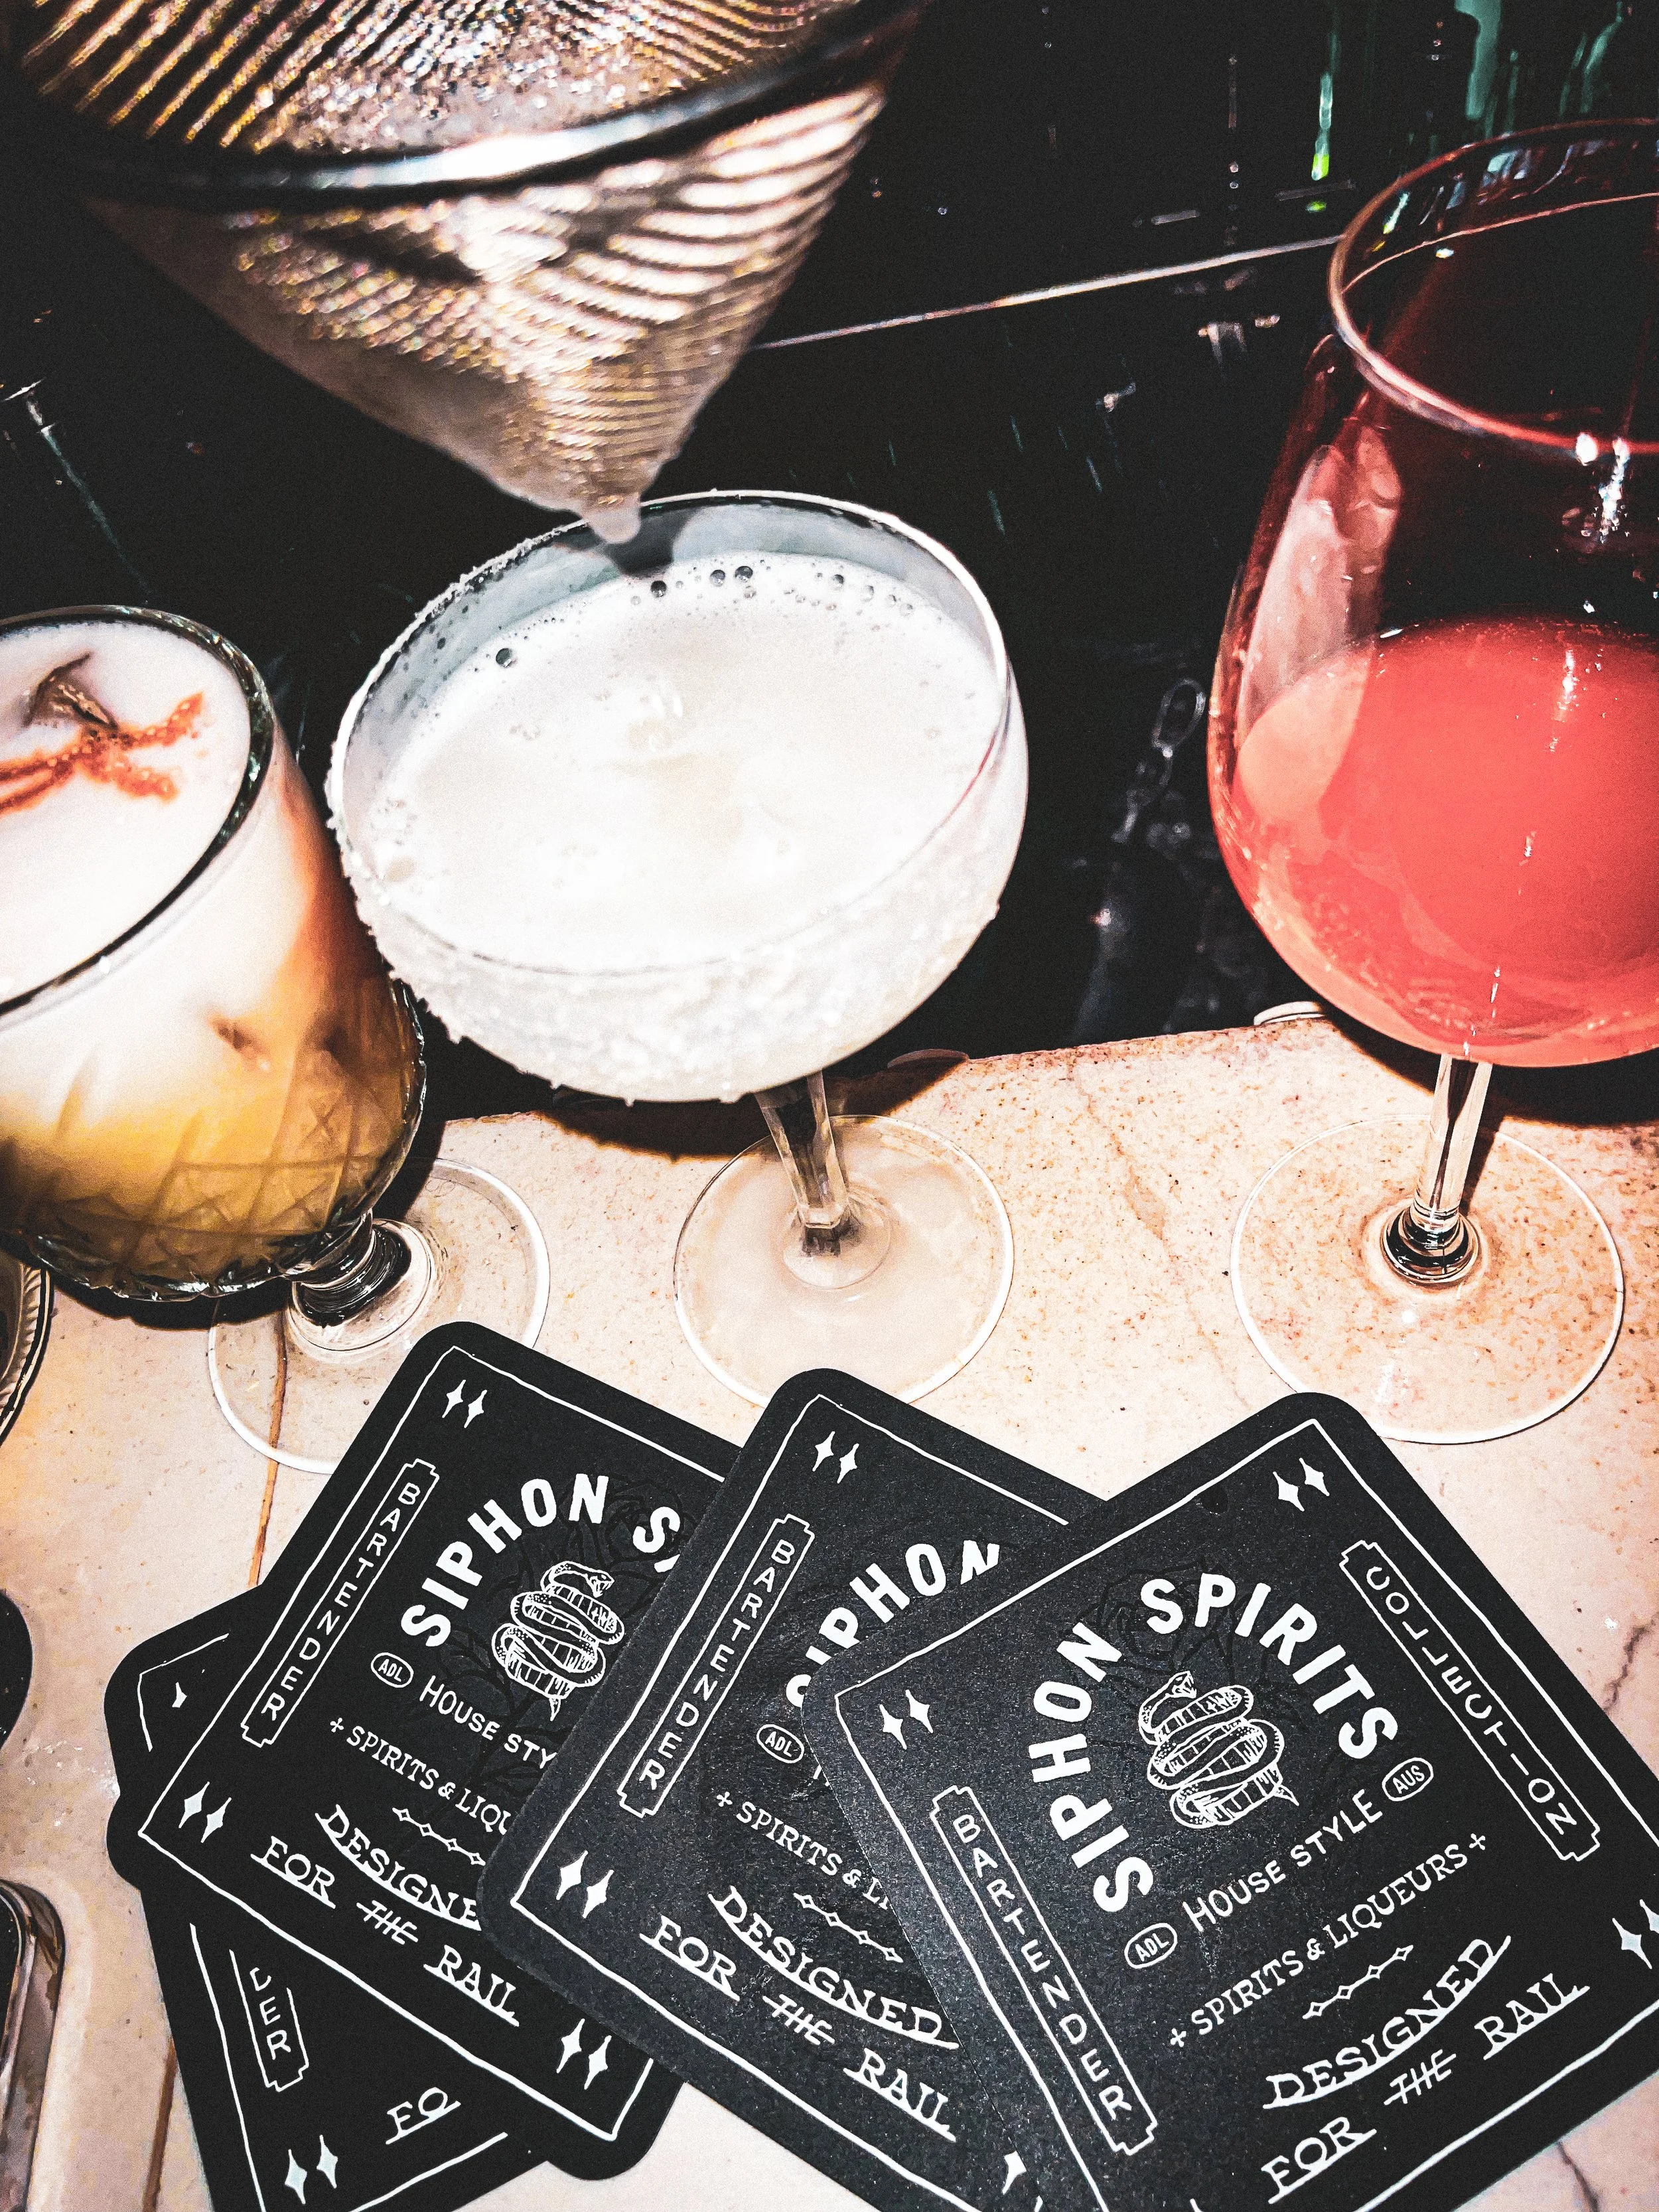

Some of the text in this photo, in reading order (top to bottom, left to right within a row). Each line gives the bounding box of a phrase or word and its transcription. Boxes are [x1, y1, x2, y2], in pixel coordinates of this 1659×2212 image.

[261, 1483, 420, 1720] BARTENDER
[401, 1474, 609, 1646] SIPHON
[378, 1659, 402, 1681] ADL
[420, 1676, 500, 1740] HOUSE
[639, 1540, 794, 1790] BARTENDER
[765, 1732, 791, 1757] ADL
[1029, 1573, 1398, 1912] SIPHON SPIRITS
[1367, 1567, 1577, 1834] COLLECTION
[347, 1726, 439, 1789] SPIRITS
[439, 1783, 455, 1799] &
[737, 1802, 861, 1887] SPIRITS &
[1394, 1766, 1424, 1793] AUS
[251, 1836, 519, 2026] FOR THE RAIL
[1183, 1789, 1382, 1932] HOUSE STYLE
[1192, 1844, 1467, 2035] SPIRITS & LIQUEURS
[640, 1915, 956, 2142] FOR THE RAIL
[708, 1886, 959, 2049] DESIGNED
[953, 1814, 1131, 2120] BARTENDER
[1135, 1933, 1169, 1961] ADL
[1263, 1936, 1510, 2108] DESIGNED
[1262, 1974, 1589, 2203] FOR THE RAIL
